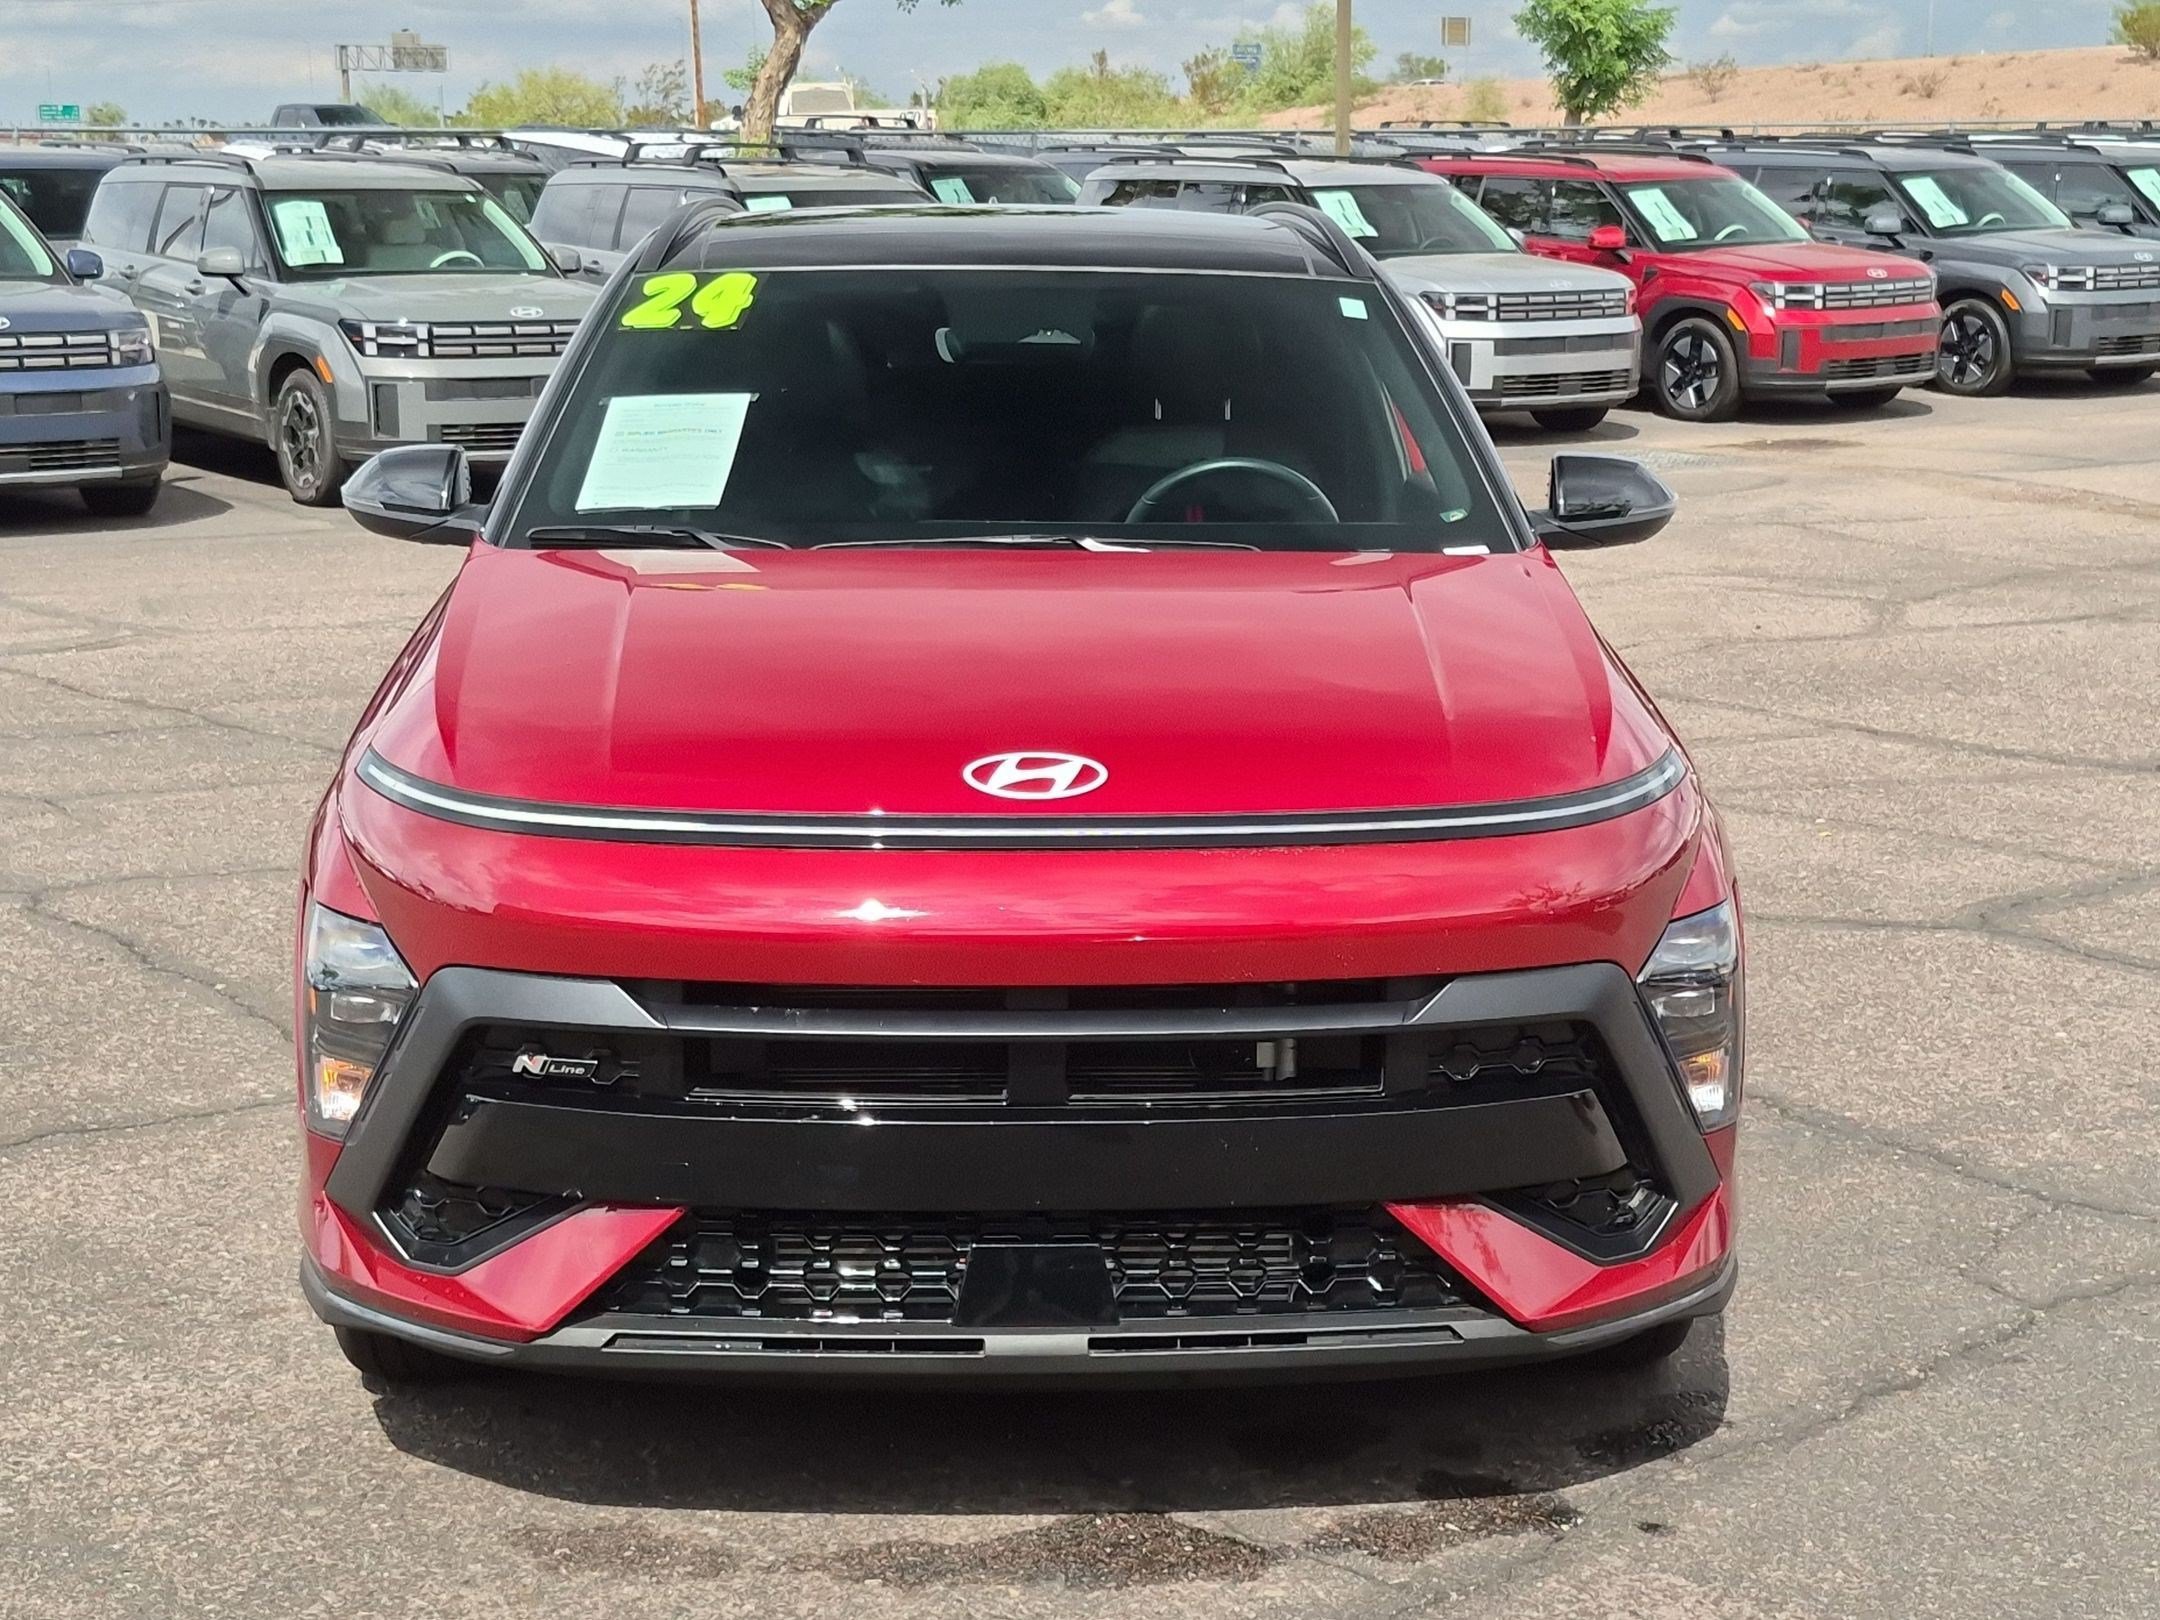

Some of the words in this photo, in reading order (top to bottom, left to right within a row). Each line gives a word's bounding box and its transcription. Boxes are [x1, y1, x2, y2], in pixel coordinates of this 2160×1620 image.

[621, 273, 757, 328] 24
[512, 1054, 546, 1075] N
[548, 1064, 586, 1075] Line
